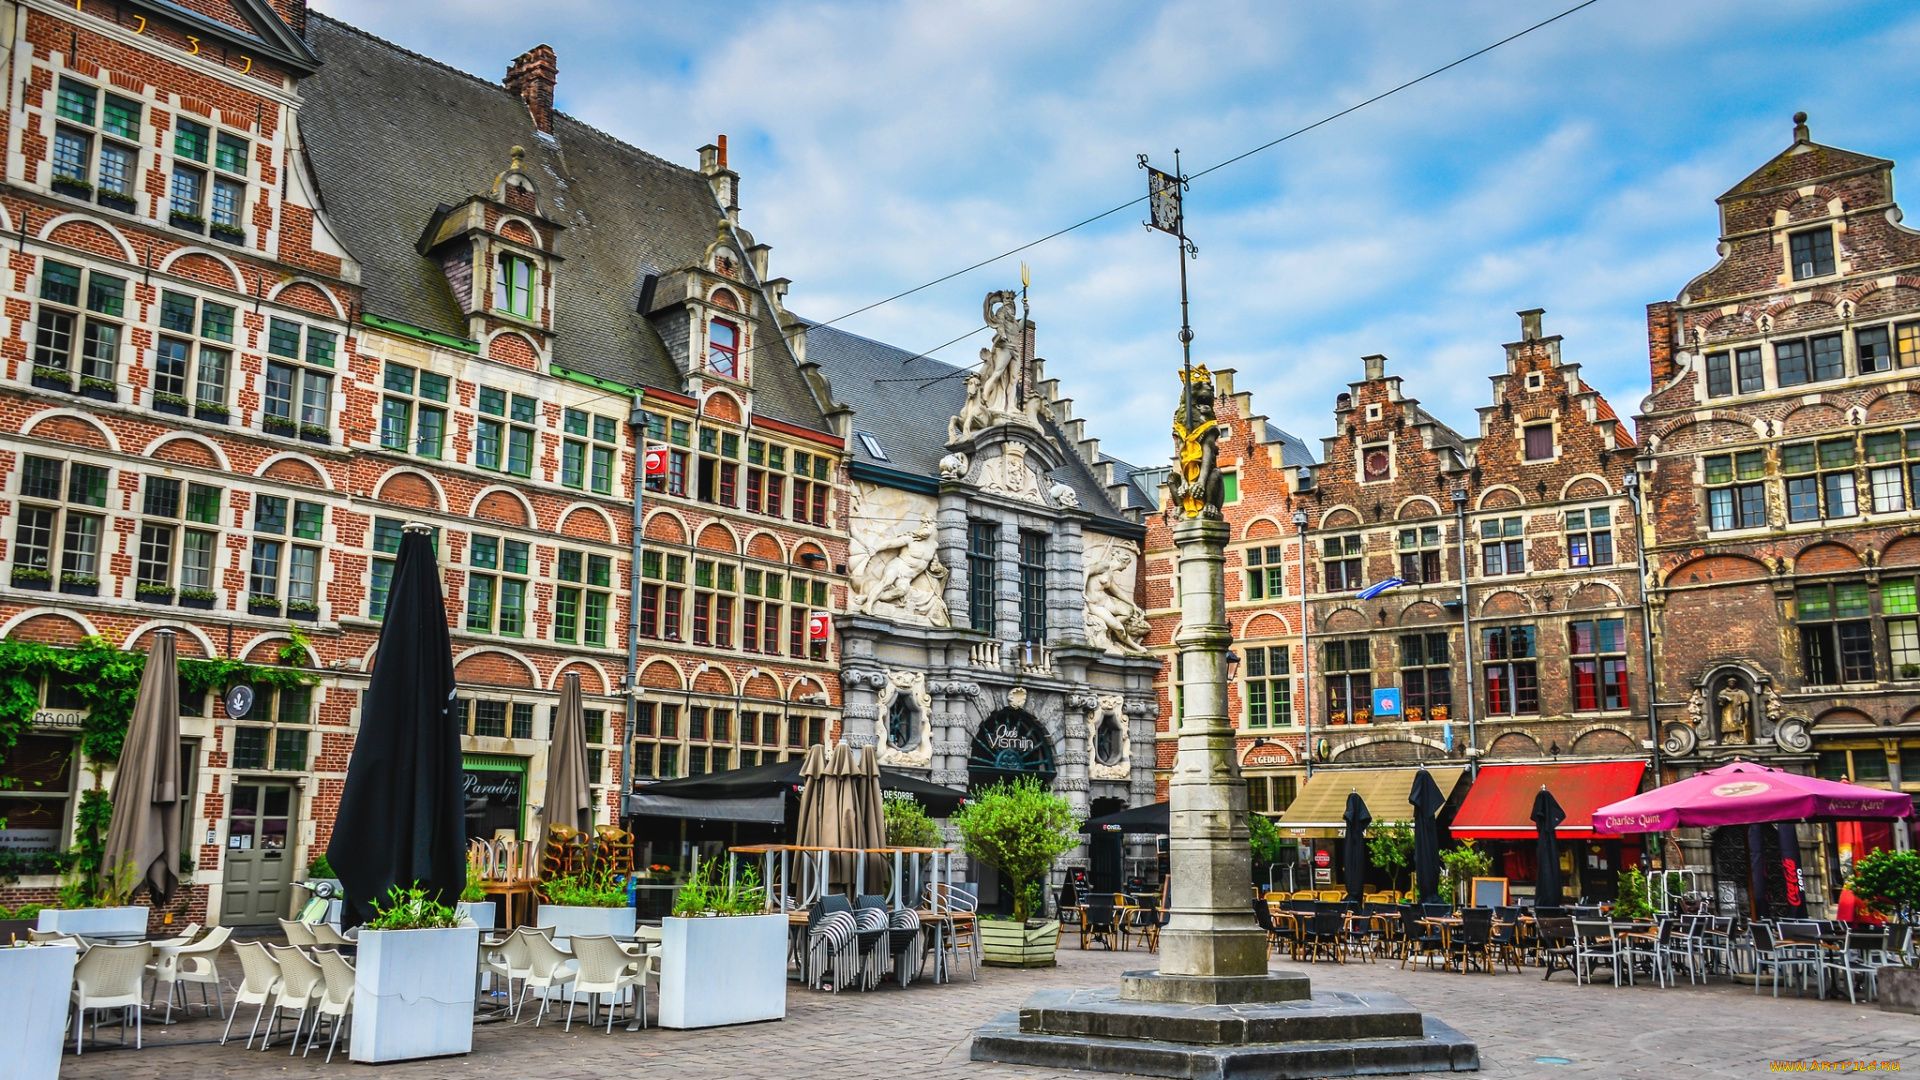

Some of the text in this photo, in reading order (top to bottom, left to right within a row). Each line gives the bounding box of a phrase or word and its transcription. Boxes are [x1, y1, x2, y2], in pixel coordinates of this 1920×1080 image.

[996, 724, 1018, 738] Oude
[988, 733, 1033, 751] Vismijn
[463, 773, 518, 802] Paradijs
[1606, 814, 1660, 828] Charles Quint
